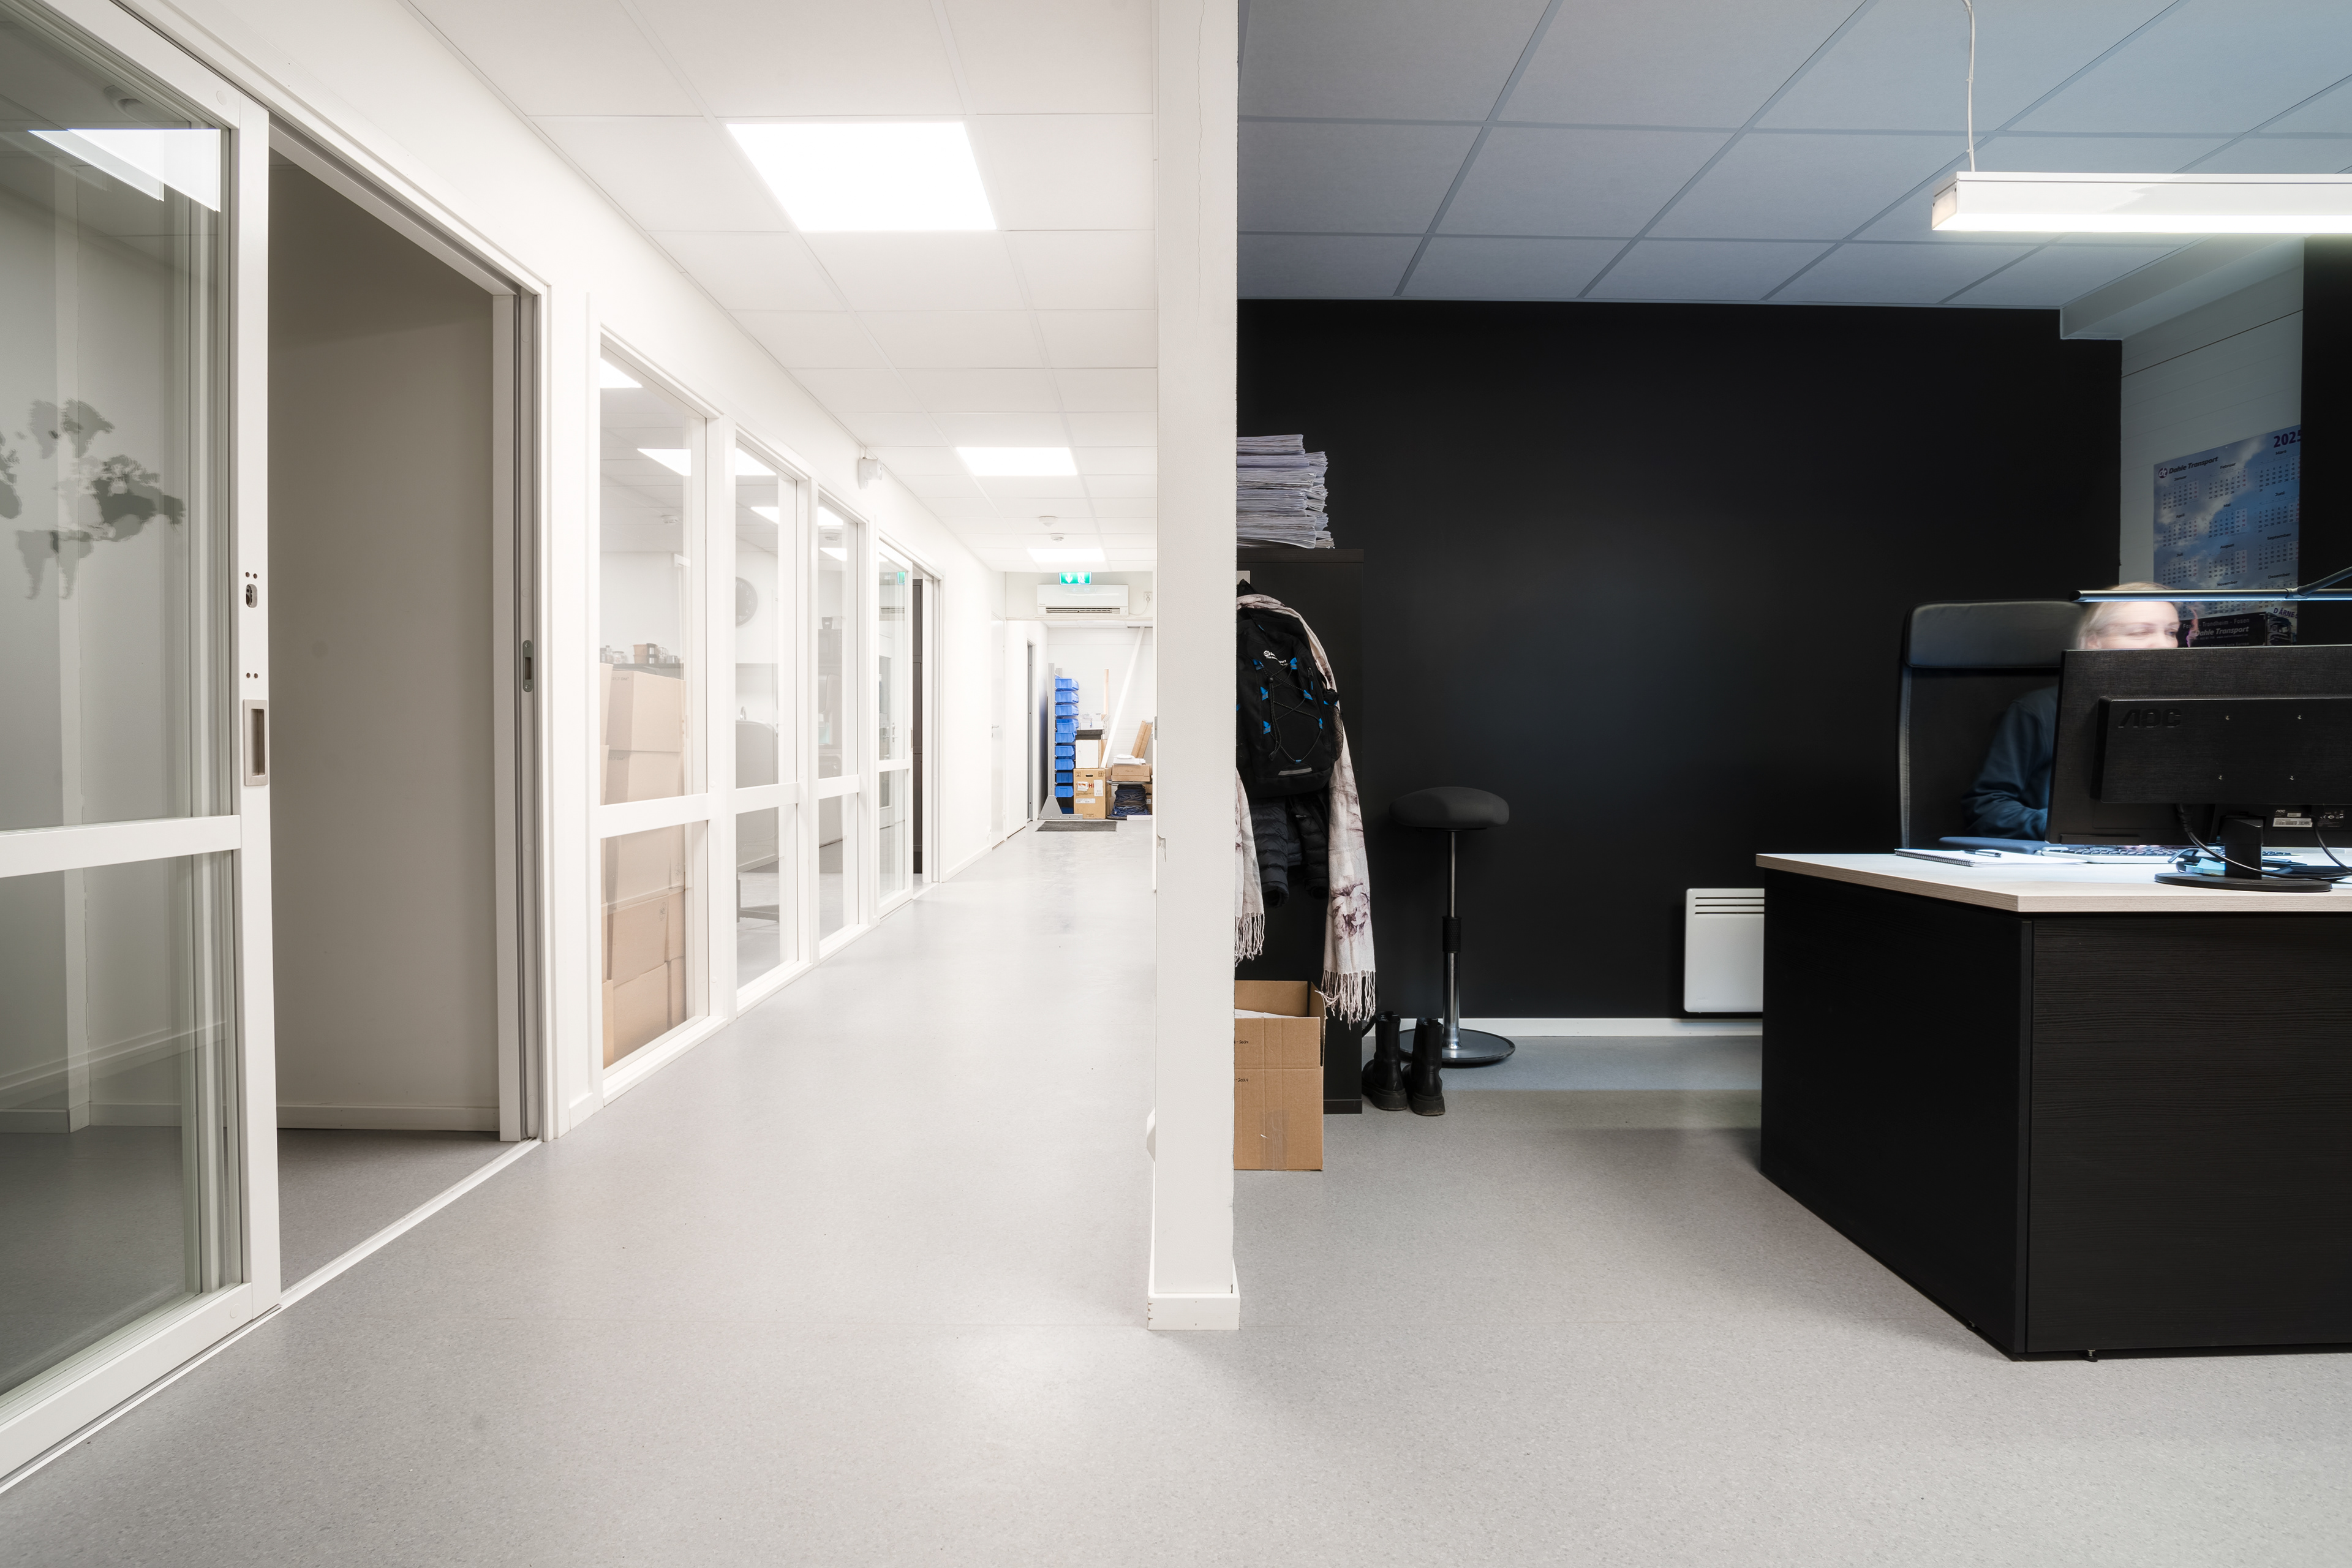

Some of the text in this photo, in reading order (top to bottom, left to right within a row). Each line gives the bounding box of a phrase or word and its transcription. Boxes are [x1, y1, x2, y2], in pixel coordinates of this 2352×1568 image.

[2169, 465, 2187, 474] Dahle
[2188, 456, 2218, 469] Transport
[2215, 626, 2249, 635] Transport
[2118, 709, 2181, 728] AOC
